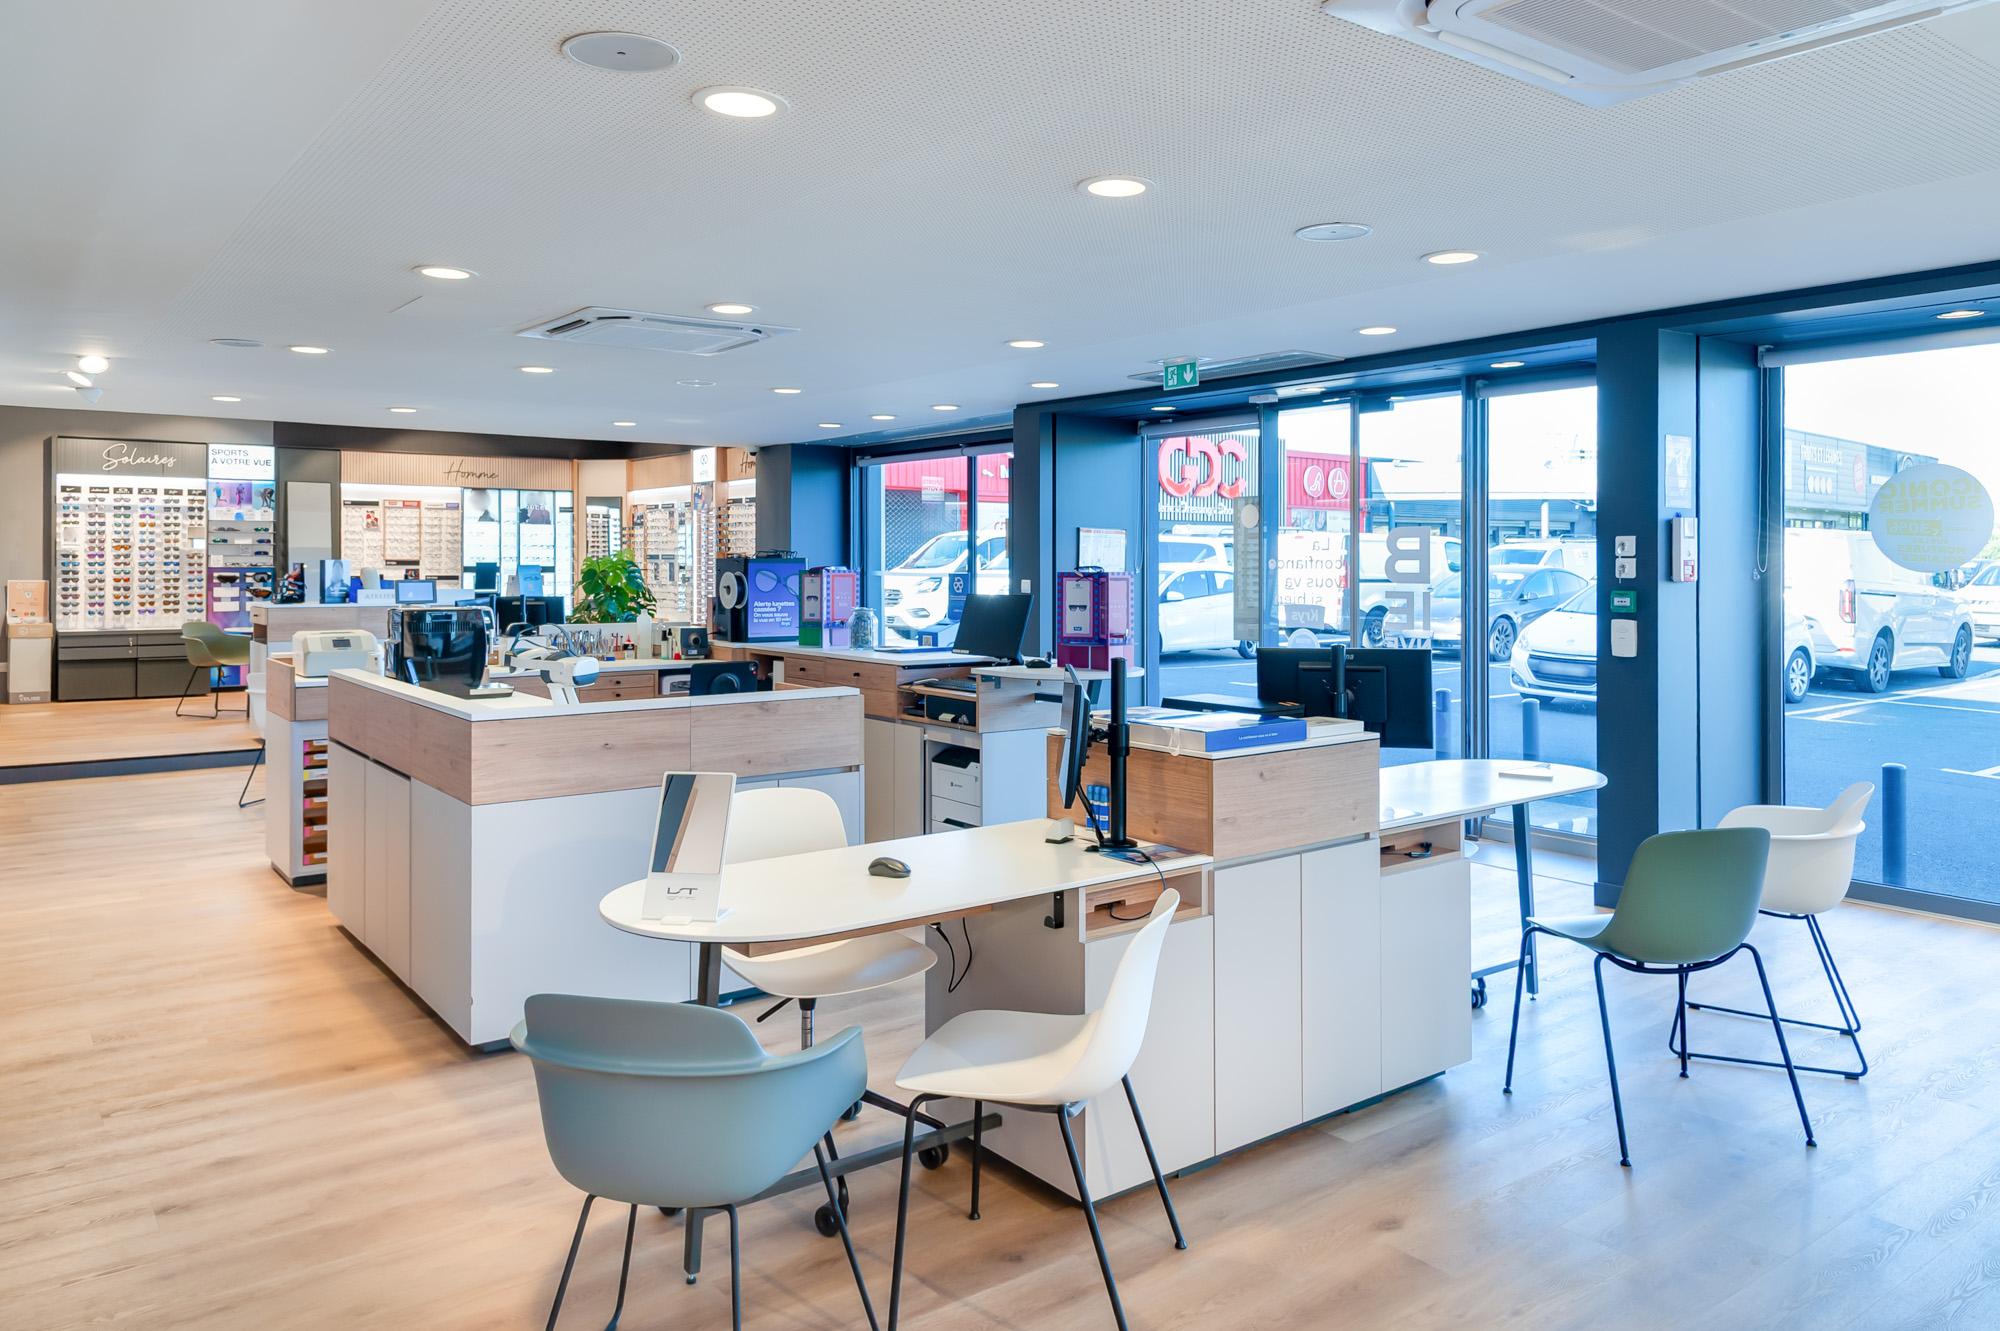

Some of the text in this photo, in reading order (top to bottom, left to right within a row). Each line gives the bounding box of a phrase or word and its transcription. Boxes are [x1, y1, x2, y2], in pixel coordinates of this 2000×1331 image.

[102, 442, 177, 471] Solaires
[211, 449, 249, 457] SPORTS
[220, 457, 251, 466] VOTRE
[253, 459, 272, 467] VUE
[443, 459, 499, 482] Homme
